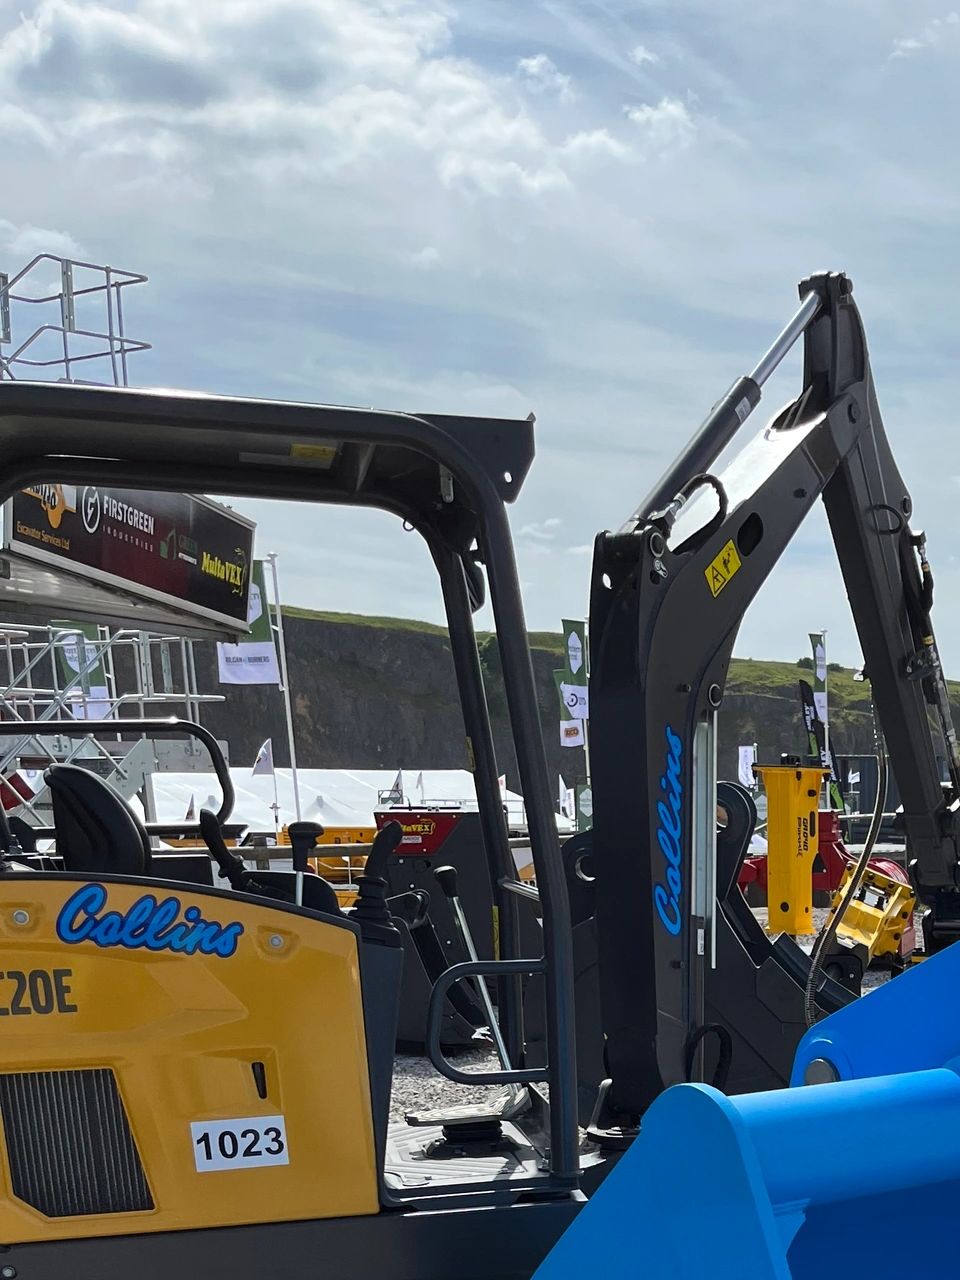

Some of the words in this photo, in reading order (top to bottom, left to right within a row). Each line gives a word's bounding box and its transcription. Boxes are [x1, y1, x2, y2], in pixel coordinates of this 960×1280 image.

[103, 495, 155, 535] FIRSTGREEN
[41, 529, 63, 548] Services
[61, 536, 70, 551] Ltd
[654, 725, 684, 937] Collins
[56, 882, 245, 958] Collins
[196, 1126, 285, 1161] 1023
